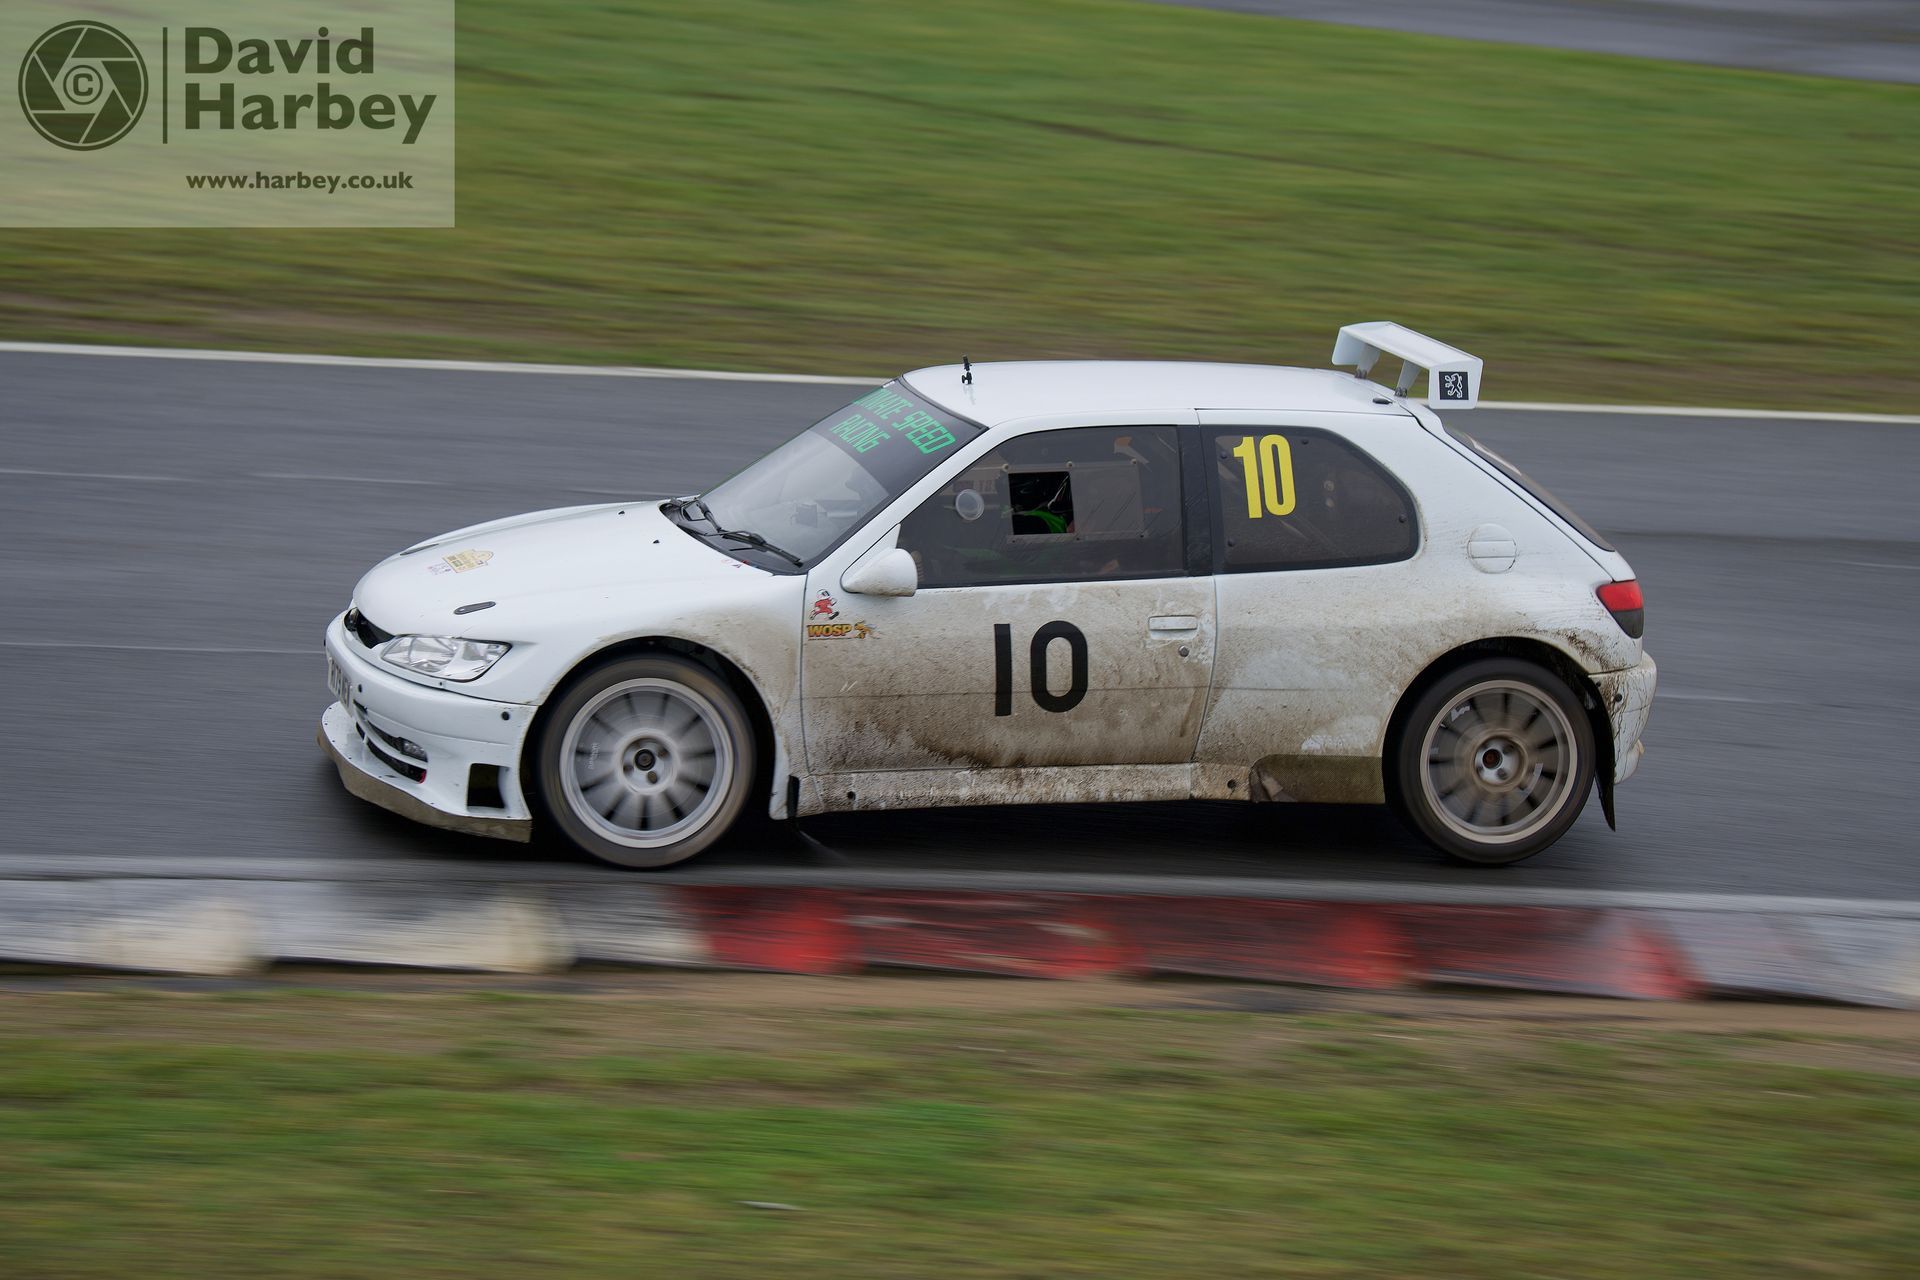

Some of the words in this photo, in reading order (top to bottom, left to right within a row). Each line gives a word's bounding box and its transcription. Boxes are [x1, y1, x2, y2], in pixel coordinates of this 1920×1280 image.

[829, 414, 891, 453] RACING
[892, 410, 956, 454] SPEED
[1233, 434, 1296, 519] 10
[806, 624, 853, 637] WOSP
[994, 620, 1088, 717] 10
